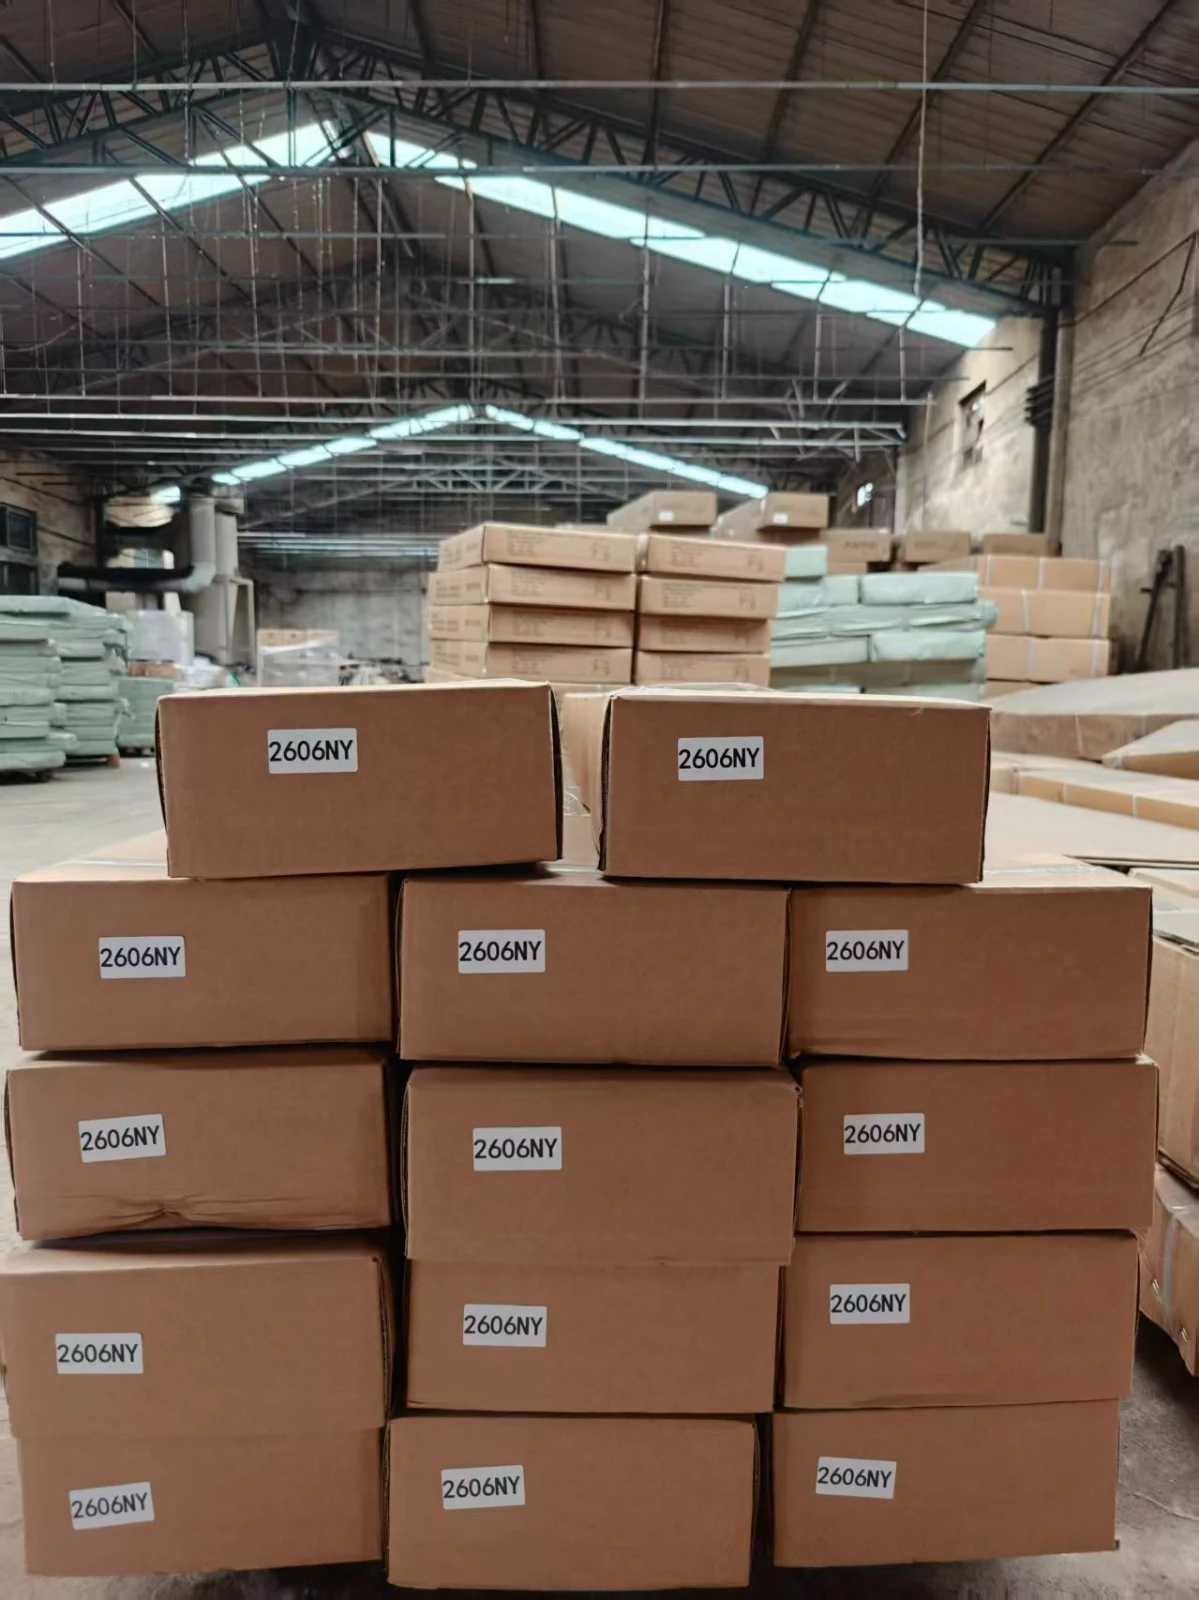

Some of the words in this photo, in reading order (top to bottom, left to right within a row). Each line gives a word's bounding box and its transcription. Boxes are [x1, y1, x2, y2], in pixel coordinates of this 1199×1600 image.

[268, 739, 354, 762] 2606NY
[678, 747, 761, 770] 2606NY
[99, 946, 181, 968] 2606NY
[458, 940, 542, 962] 2606NY
[826, 940, 905, 961] 2606NY
[80, 1124, 160, 1152] 2606NY
[844, 1122, 921, 1144] 2606NY
[473, 1137, 558, 1159] 2606NY
[830, 1293, 907, 1314] 2606NY
[463, 1314, 544, 1336] 2606NY
[57, 1343, 138, 1363] 2606NY
[442, 1475, 521, 1499] 2606NY
[817, 1466, 893, 1489] 2606NY
[71, 1492, 148, 1519] 2606NY
